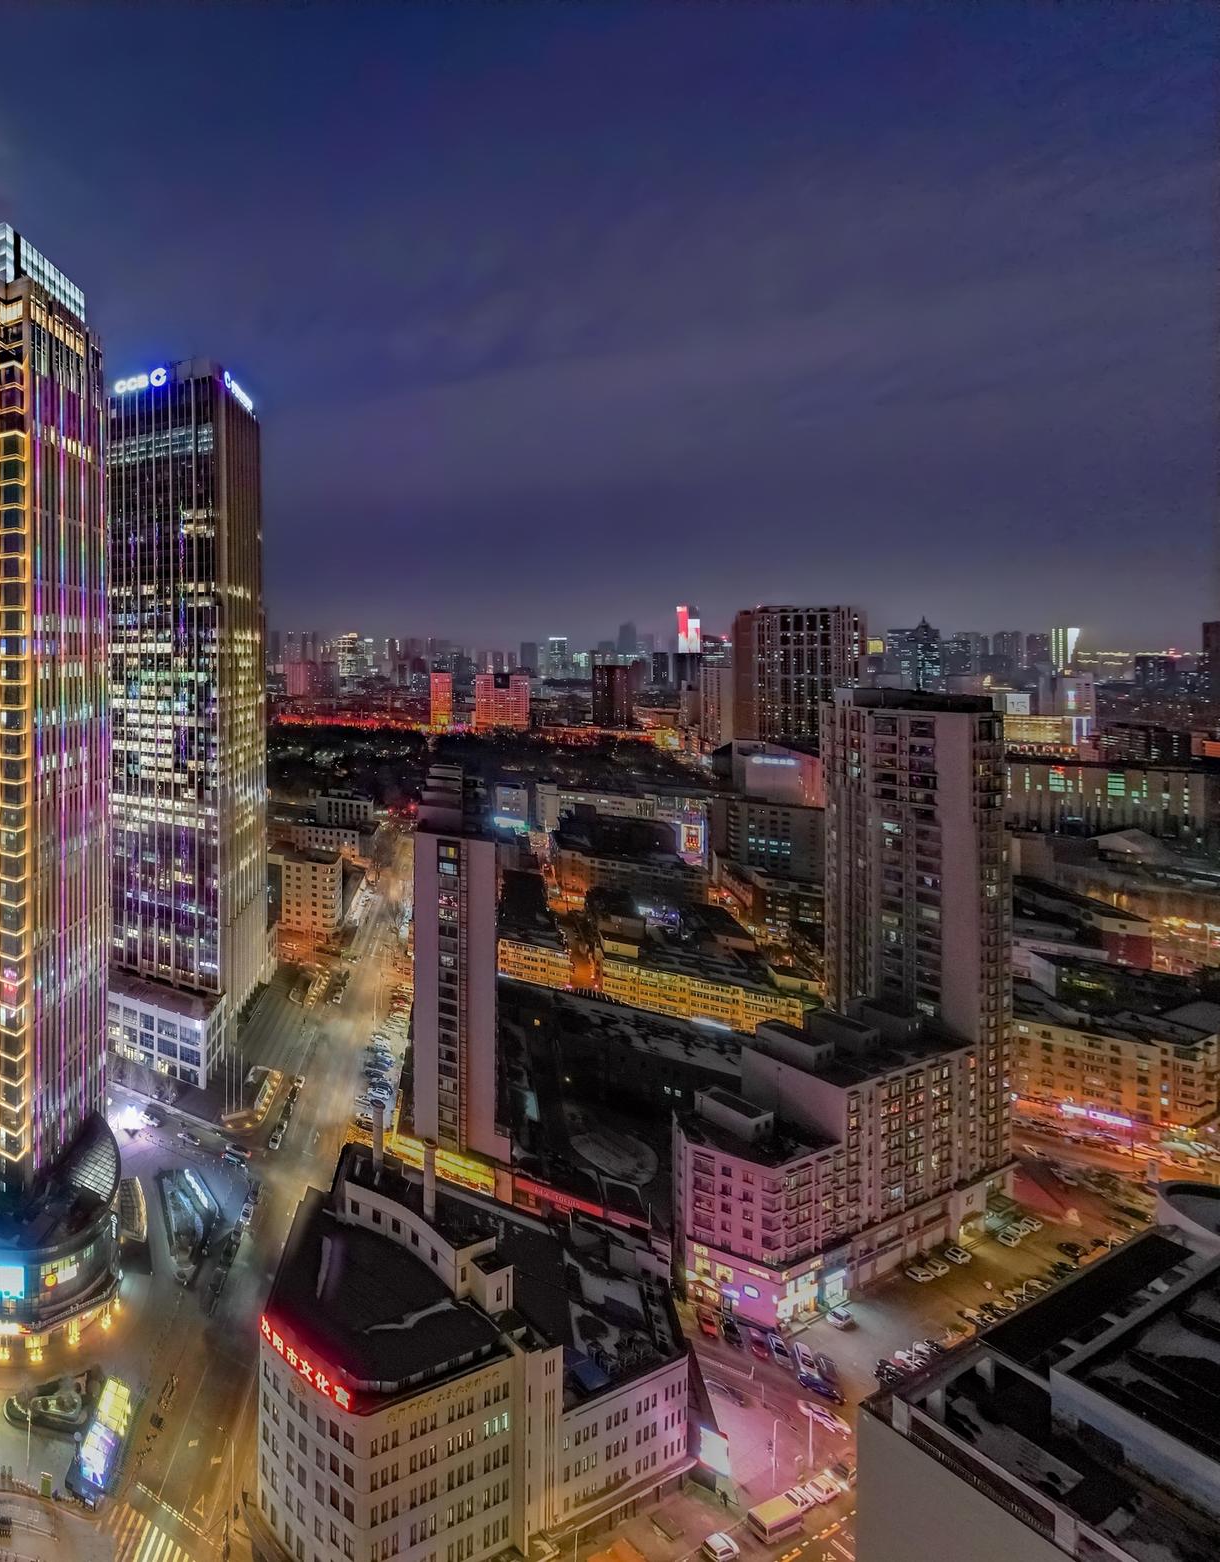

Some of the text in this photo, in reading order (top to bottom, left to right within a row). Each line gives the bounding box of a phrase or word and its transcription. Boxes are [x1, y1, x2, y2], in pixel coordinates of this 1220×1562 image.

[261, 1315, 350, 1410] 沈阳市文化宫
